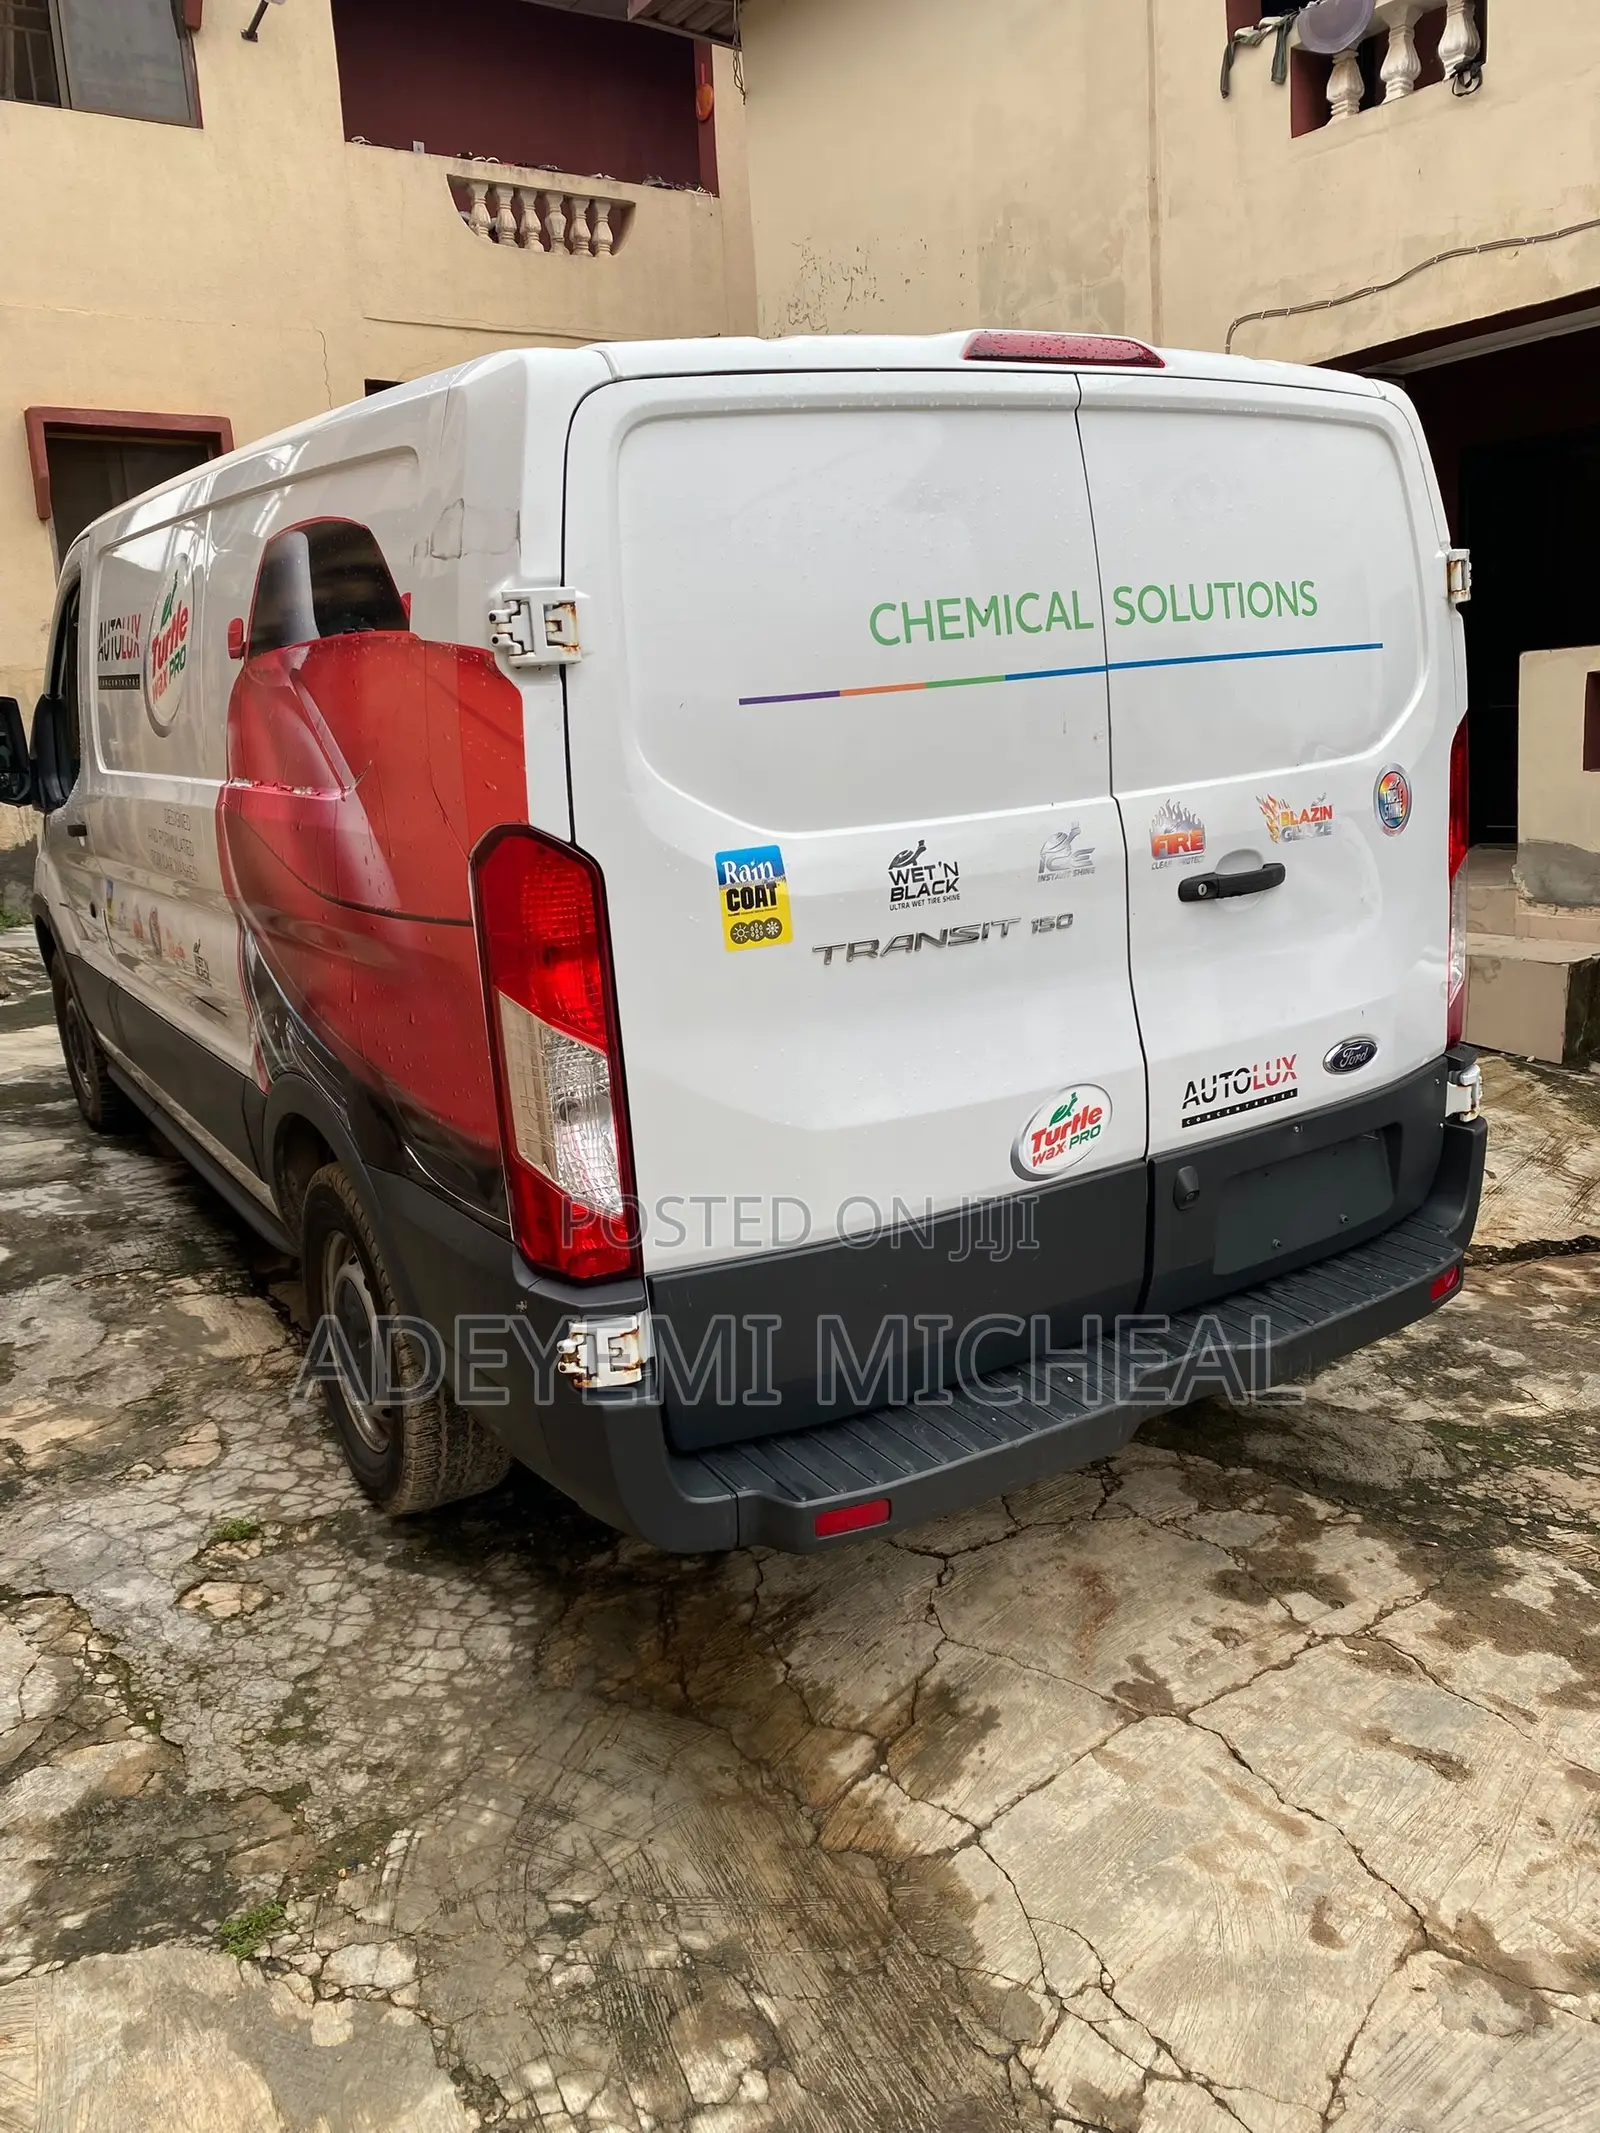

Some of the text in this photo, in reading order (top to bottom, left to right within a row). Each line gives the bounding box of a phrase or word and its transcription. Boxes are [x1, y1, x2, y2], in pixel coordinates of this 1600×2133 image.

[869, 579, 1318, 646] CHEMICAL SOLUTIONS
[98, 613, 141, 662] AUTOLUX
[152, 600, 189, 679] Turtle
[169, 644, 187, 684] PRO
[1280, 804, 1333, 827] BLAZIN
[1151, 829, 1205, 858] FIRE
[721, 858, 776, 885] Rain
[1072, 866, 1096, 878] SHINE
[726, 882, 778, 912] COAT
[889, 893, 961, 912] ULTRA WET TIRE SHINE
[890, 877, 960, 903] BLACK
[811, 913, 1074, 966] TRANSIT 150
[1339, 1043, 1370, 1069] Ford
[1182, 1054, 1298, 1110] AUTOLUX
[1030, 1103, 1103, 1154] Turtle
[1032, 1123, 1102, 1168] wax PRO
